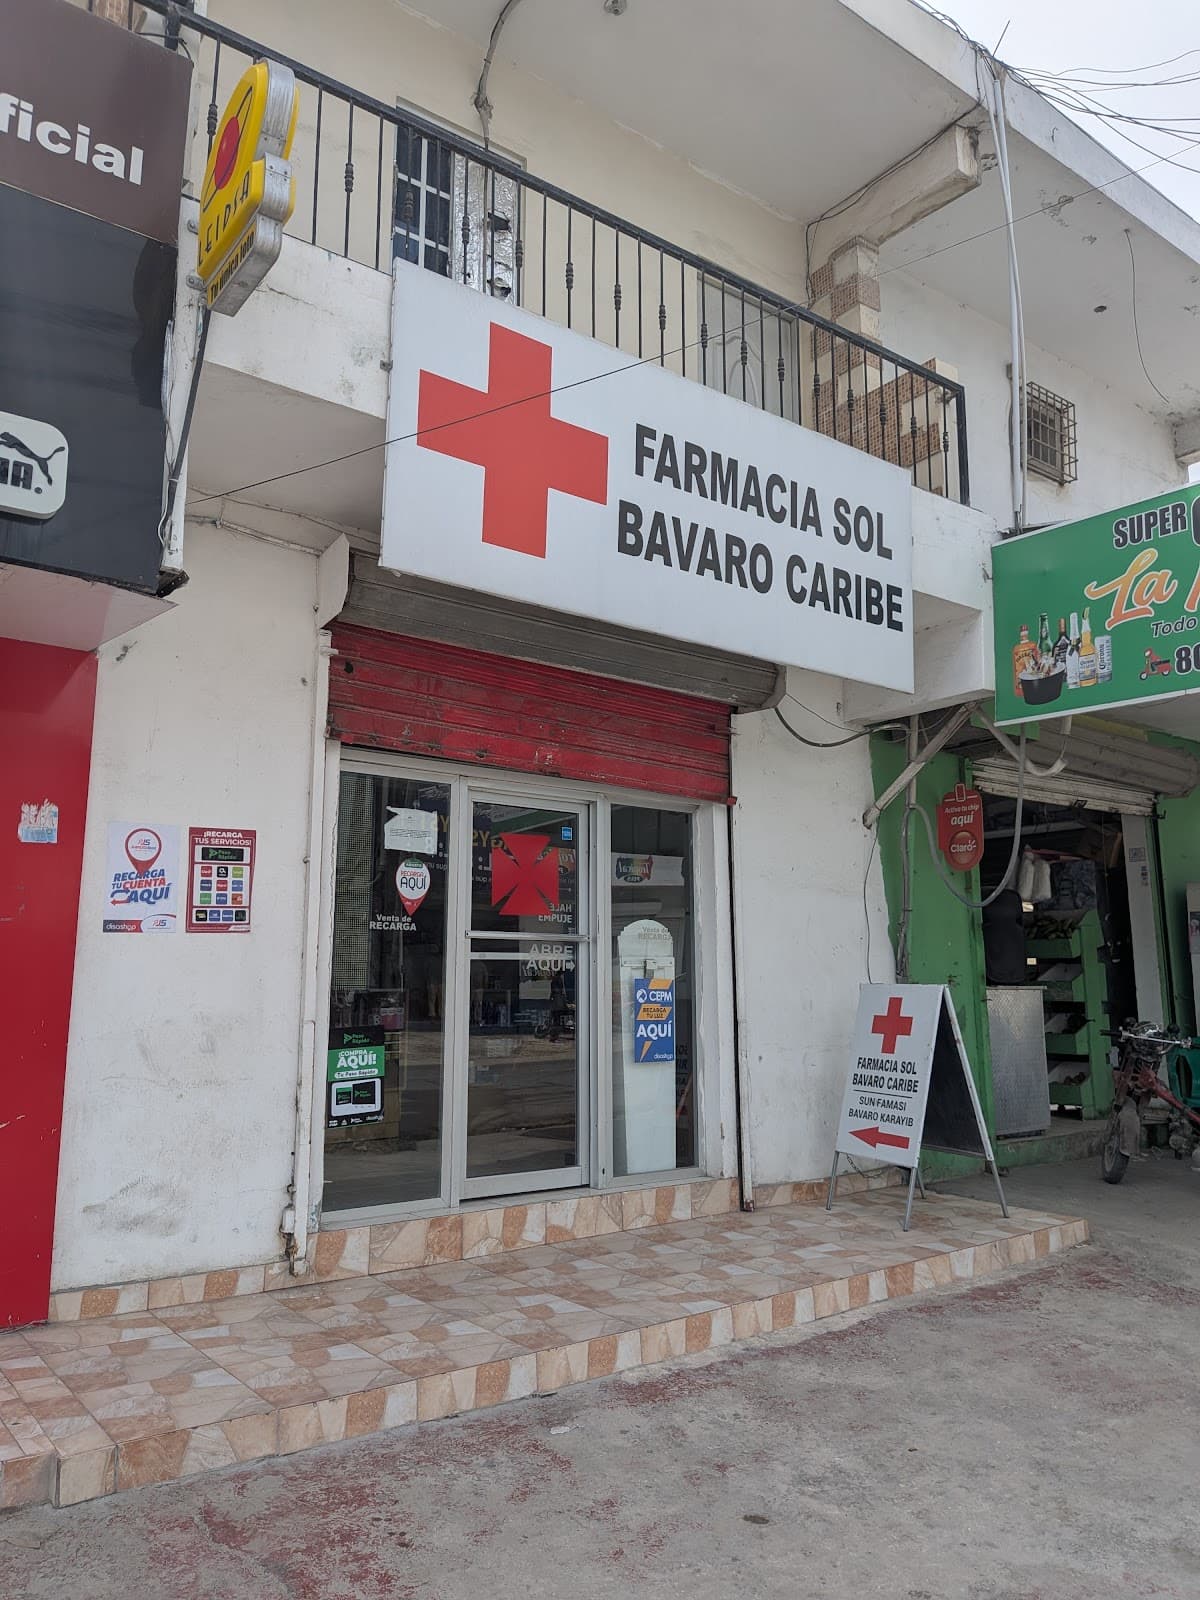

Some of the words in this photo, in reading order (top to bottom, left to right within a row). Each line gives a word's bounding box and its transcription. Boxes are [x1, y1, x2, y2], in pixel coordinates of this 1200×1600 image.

[198, 170, 250, 267] LEIDSA
[635, 423, 823, 537] FARMACIA
[833, 497, 893, 560] SOL
[1113, 502, 1188, 549] SUPER
[617, 499, 773, 594] BAVARO
[785, 554, 904, 632] CARIBE
[1084, 548, 1178, 630] La
[1151, 616, 1197, 637] Todo
[951, 811, 974, 828] aquí
[950, 842, 974, 853] Claro
[111, 882, 122, 890] TU
[122, 878, 166, 890] CUENTA
[113, 869, 165, 882] RECARGA
[400, 876, 427, 891] AQUÍ
[128, 882, 172, 905] AQUÍ
[369, 921, 417, 931] RECARGA
[376, 914, 398, 922] Venta
[538, 914, 573, 923] EMPUJE
[649, 991, 673, 1002] CEPM
[636, 1020, 672, 1040] AQUÍ
[337, 1050, 377, 1069] AQUÍ!
[857, 1057, 898, 1073] FARMACIA
[900, 1061, 917, 1075] SOL
[852, 1073, 885, 1088] BAVARO
[886, 1077, 919, 1093] CARIBE
[859, 1096, 875, 1107] SUN
[876, 1098, 907, 1111] FAMASI
[848, 1108, 879, 1121] BAVARO
[880, 1113, 914, 1127] KARAYIB
